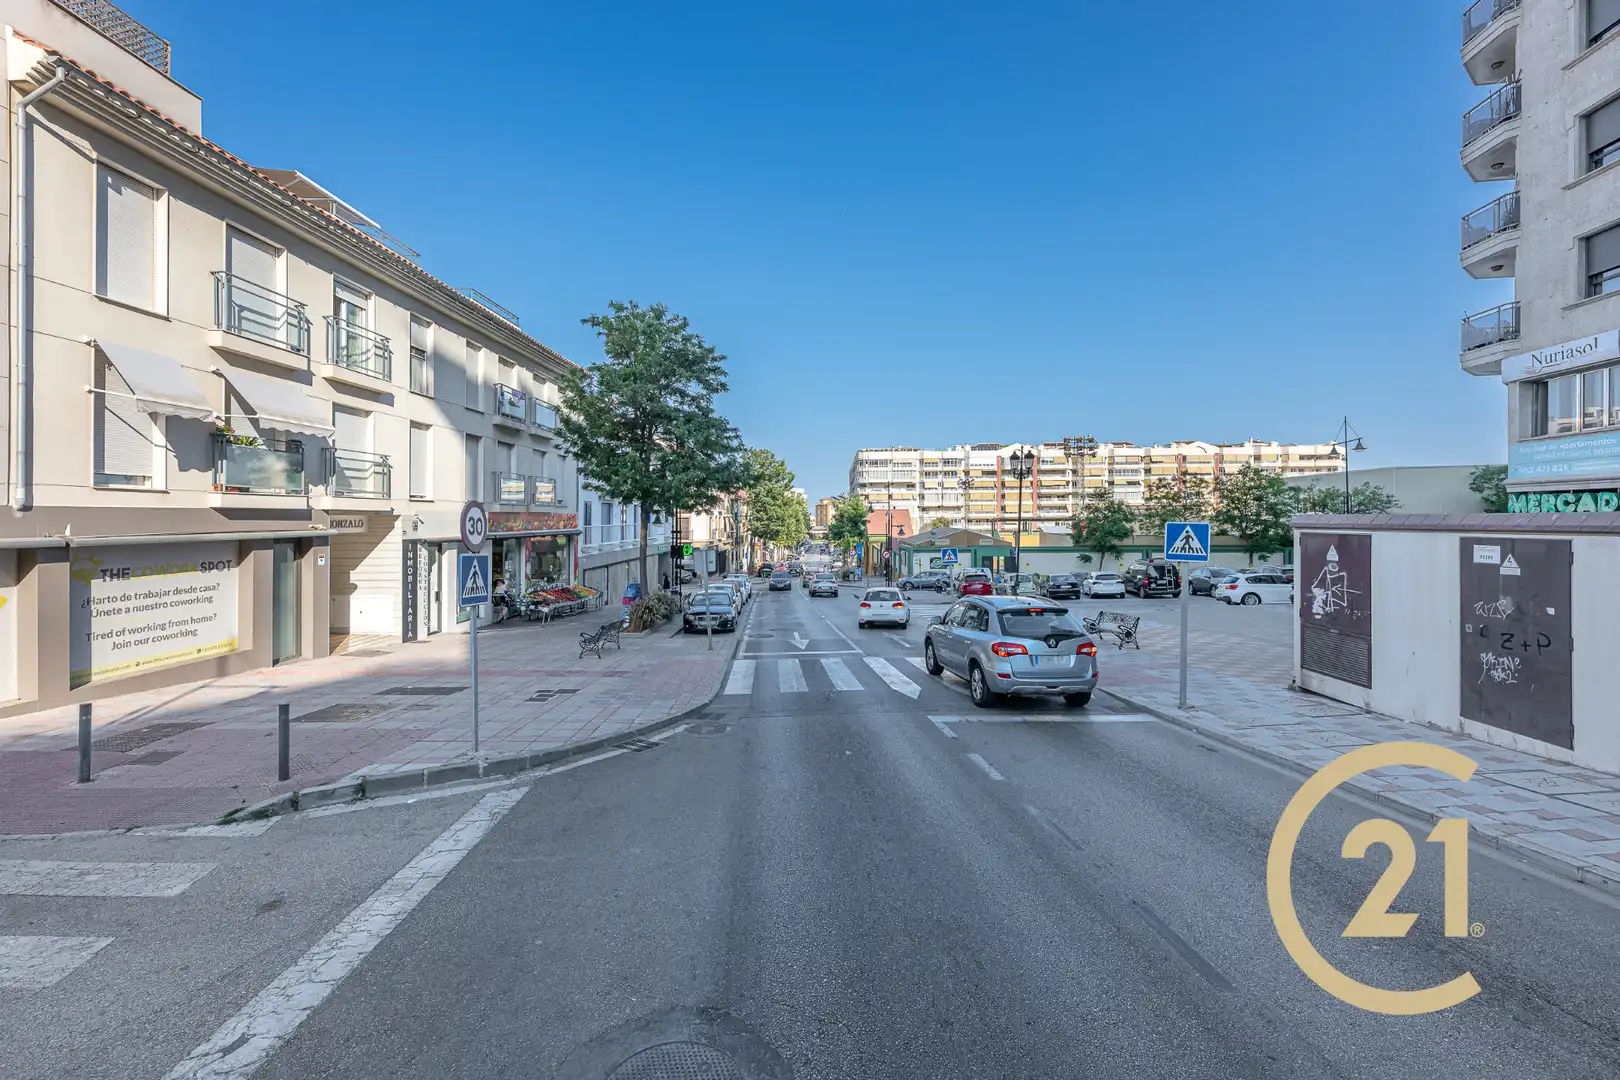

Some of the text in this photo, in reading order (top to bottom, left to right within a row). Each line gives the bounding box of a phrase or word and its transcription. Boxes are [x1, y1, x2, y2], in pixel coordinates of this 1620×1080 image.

[1531, 337, 1598, 367] Nuriasol
[1508, 492, 1620, 513] MERCAD
[468, 517, 483, 537] 30
[81, 582, 220, 609] ¿Harto de trabajar desde casa?
[91, 595, 214, 618] Únete a nuestro coworking
[85, 612, 217, 642] Tired of working from home?
[111, 628, 198, 651] Join our coworking
